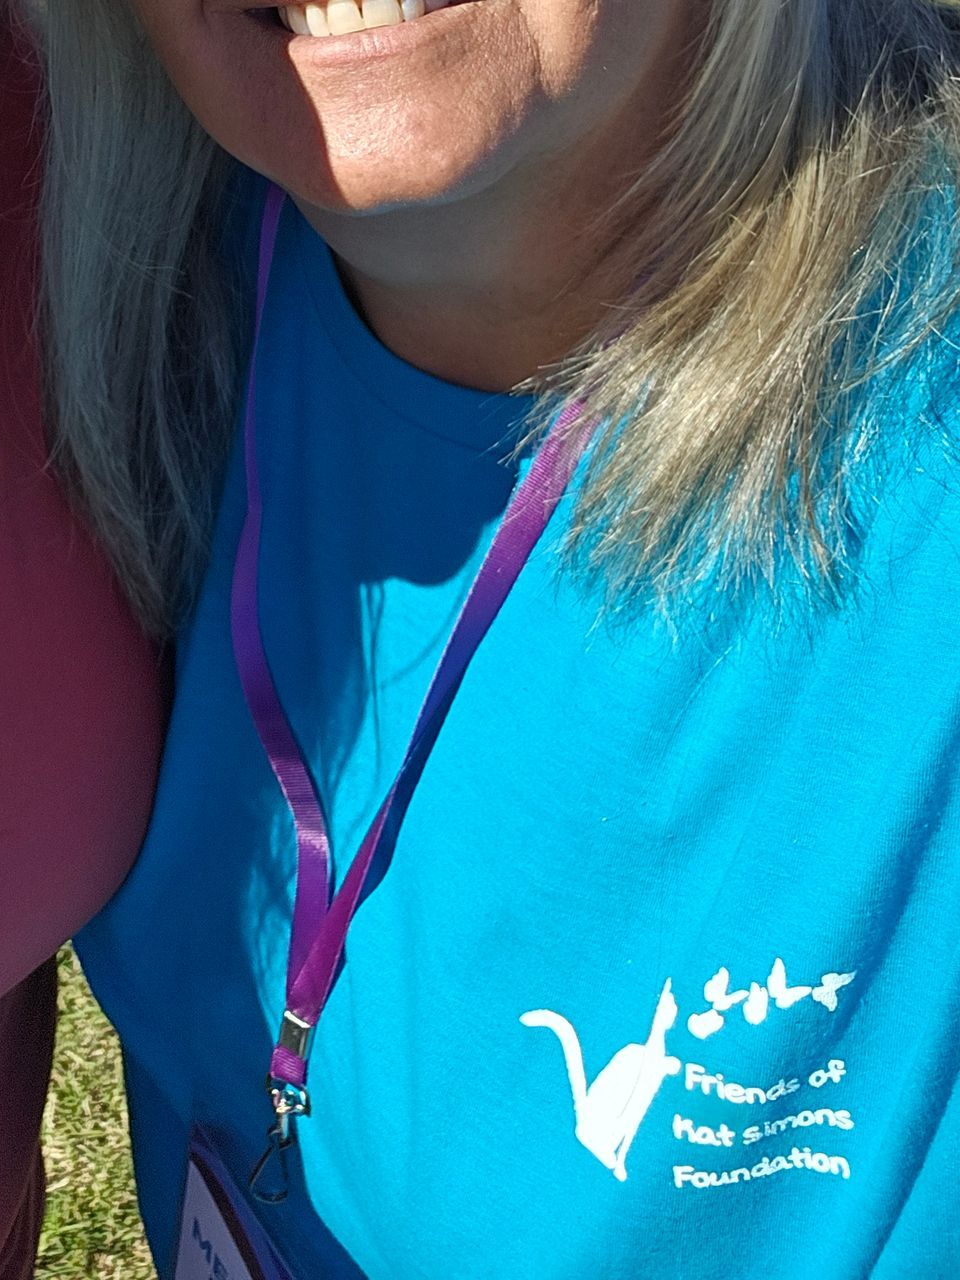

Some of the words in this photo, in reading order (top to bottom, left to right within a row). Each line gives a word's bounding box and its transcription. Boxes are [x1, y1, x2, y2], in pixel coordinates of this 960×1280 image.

[685, 1062, 800, 1104] Friends
[808, 1059, 847, 1088] of
[672, 1147, 851, 1188] Foundation
